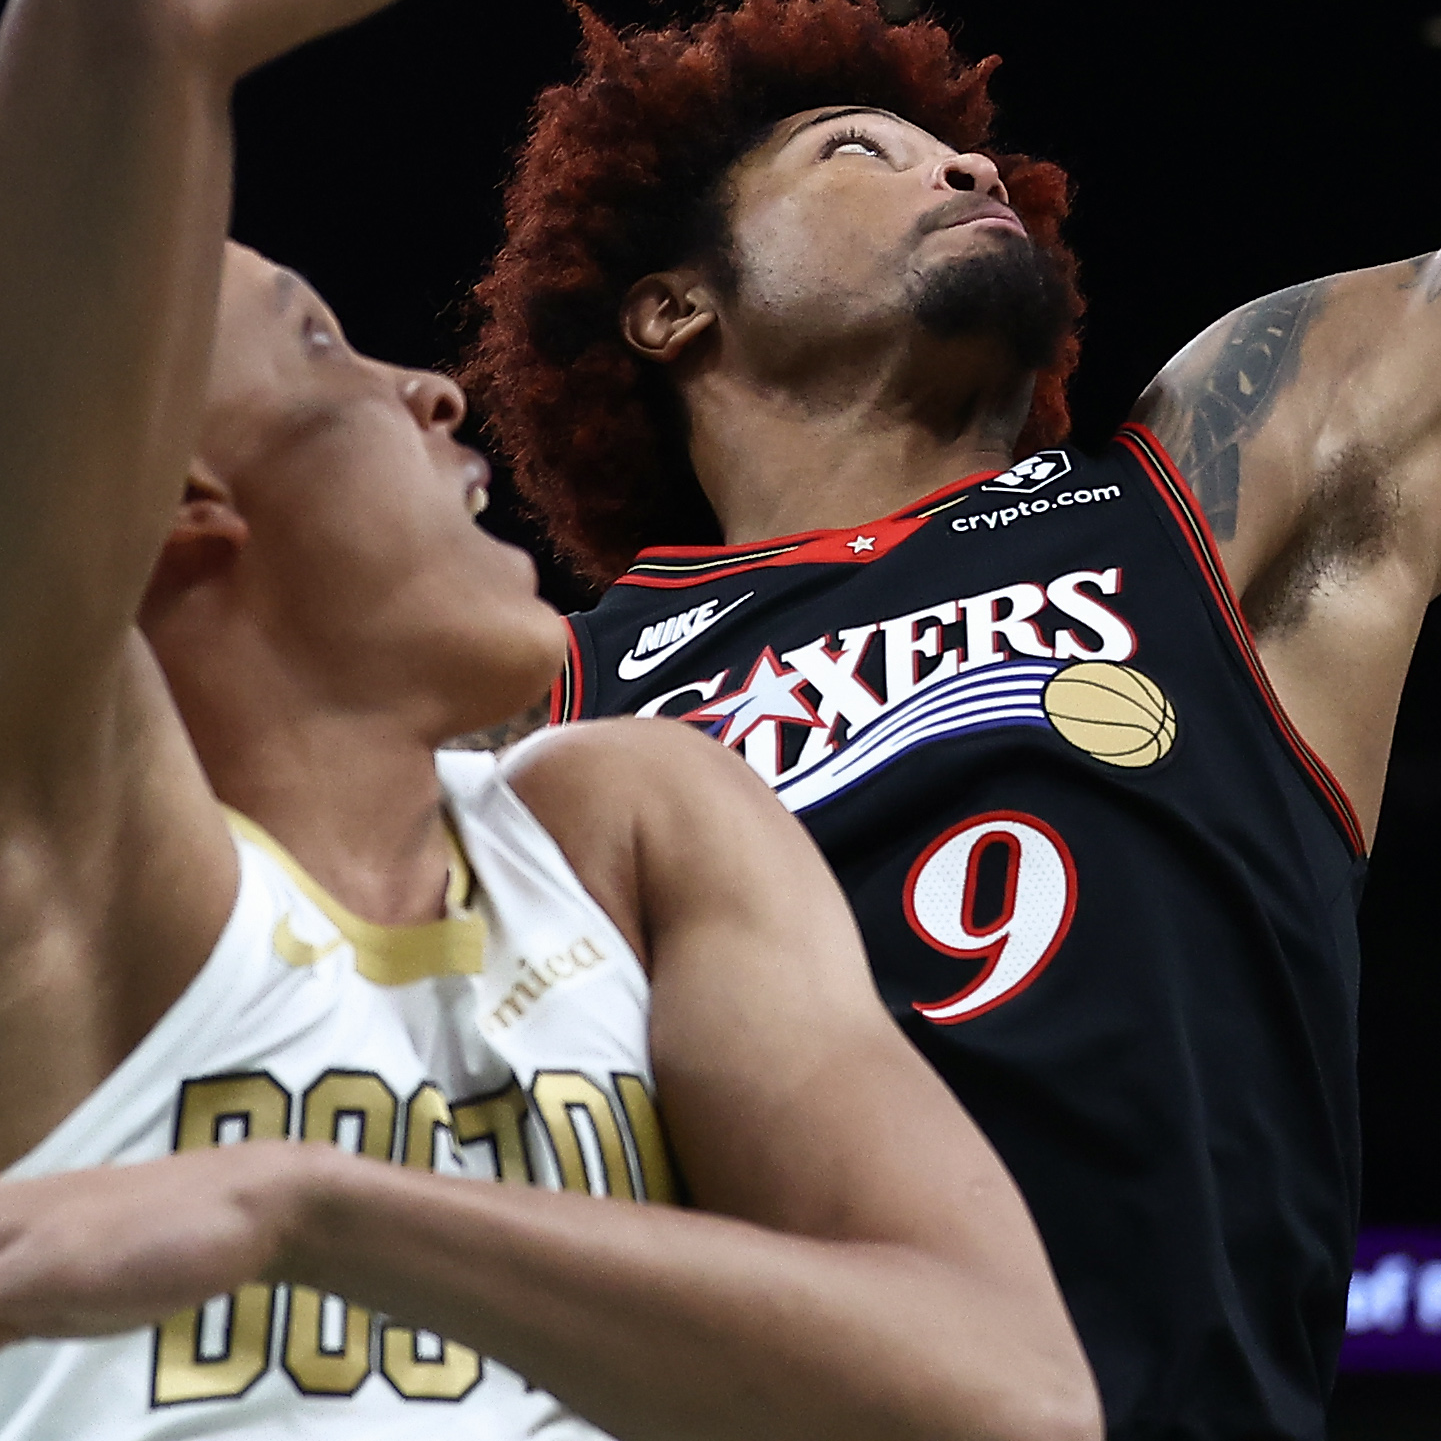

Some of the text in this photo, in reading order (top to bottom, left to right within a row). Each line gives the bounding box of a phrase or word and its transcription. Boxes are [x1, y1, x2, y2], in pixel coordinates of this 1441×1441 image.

[951, 481, 1121, 534] crypto.com
[634, 599, 719, 657] NIKE
[902, 809, 1078, 1026] 9
[484, 936, 607, 1034] mica
